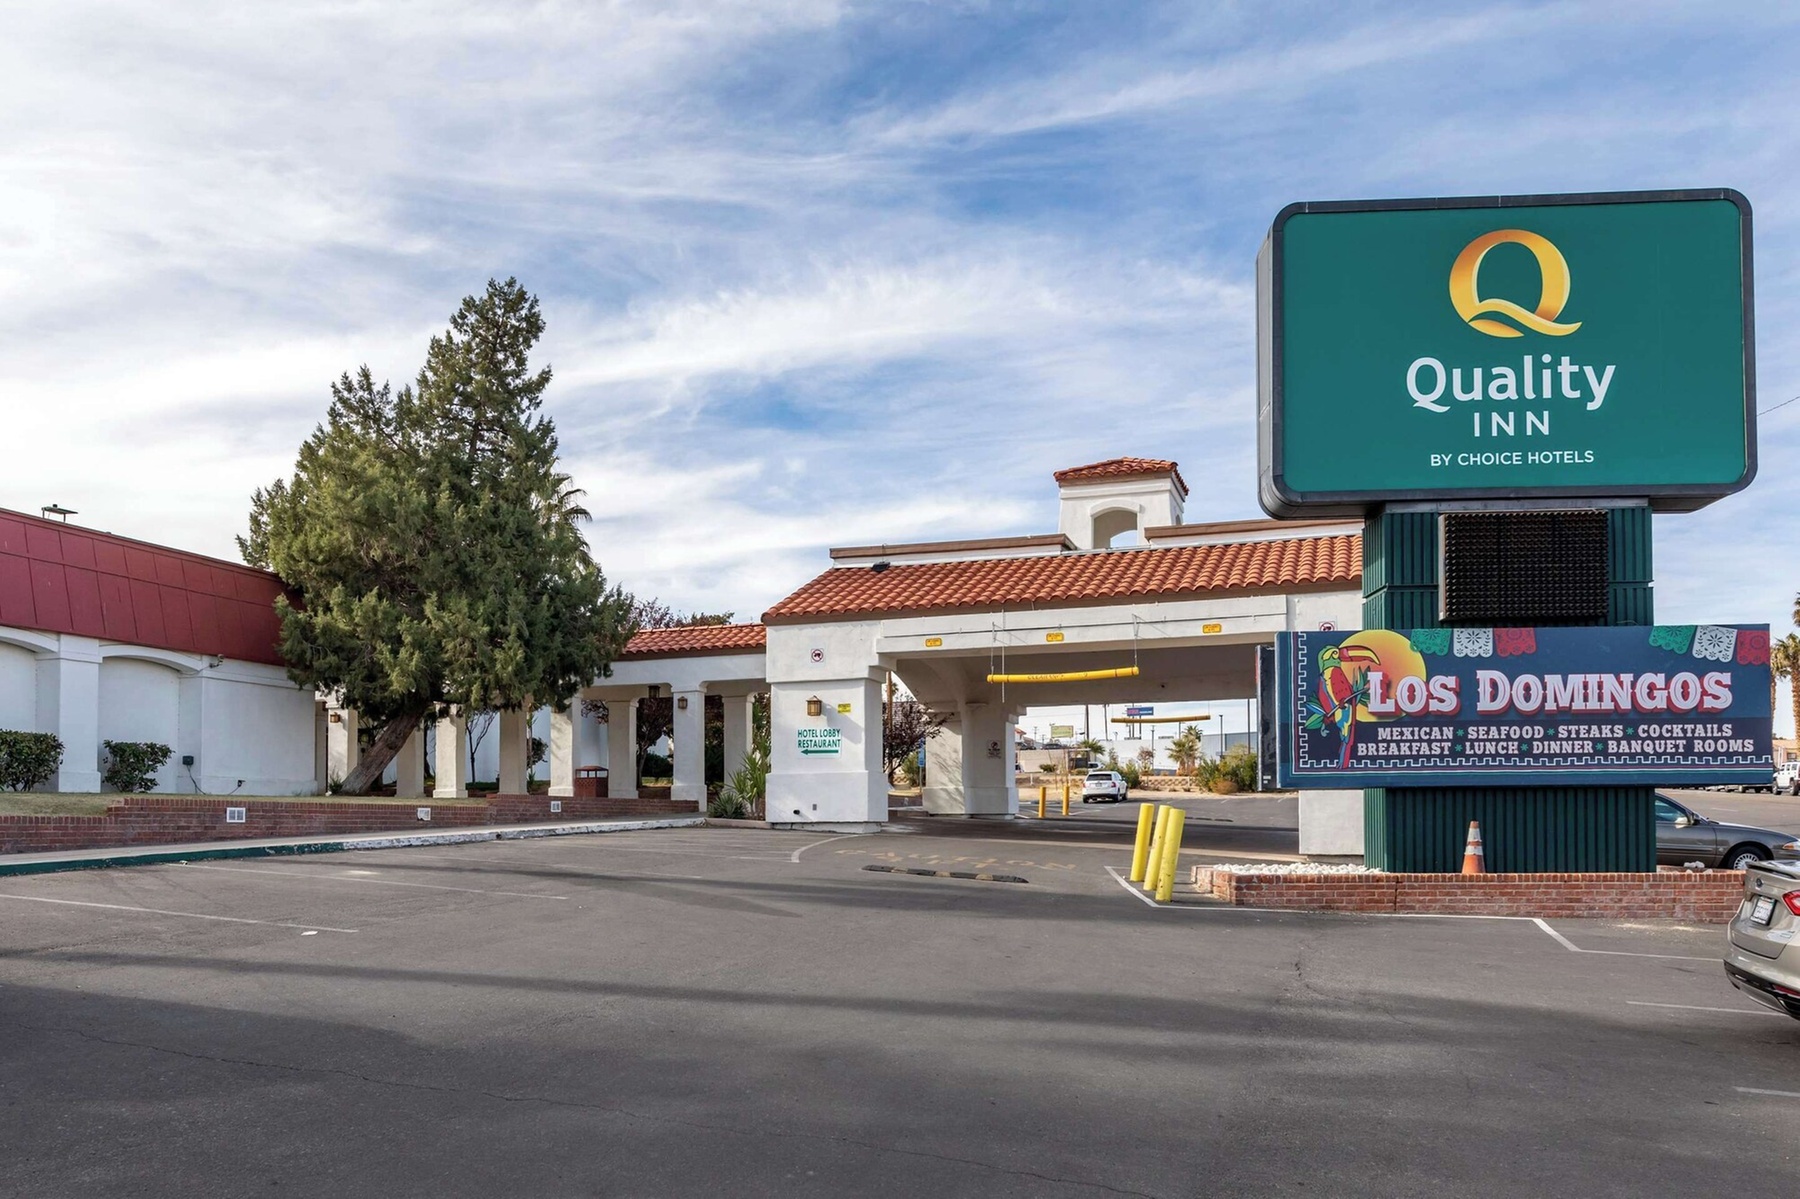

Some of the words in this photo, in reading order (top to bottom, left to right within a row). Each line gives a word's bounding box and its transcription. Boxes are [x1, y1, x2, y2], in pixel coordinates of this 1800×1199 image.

[1449, 229, 1582, 338] Q
[1406, 354, 1616, 413] Quality
[1474, 411, 1549, 437] INN
[1430, 454, 1452, 466] BY
[1458, 452, 1522, 465] CHOICE
[1528, 450, 1594, 464] HOTELS
[1367, 671, 1460, 716] LOS
[1476, 670, 1733, 715] DOMINGOS
[797, 729, 818, 738] HOTEL
[820, 729, 841, 738] LOBBY
[1377, 726, 1454, 740] MEXICAN
[1467, 725, 1544, 739] SEAFOOD
[1558, 725, 1623, 738] STEAKS
[1638, 724, 1733, 737] COCKTAILS
[797, 739, 841, 748] RESTAURANT
[1357, 743, 1451, 756] BREAKFAST
[1465, 742, 1519, 755] LUNCH
[1532, 741, 1594, 754] DINNER
[1608, 740, 1686, 754] BANQUET
[1693, 739, 1754, 753] ROOMS
